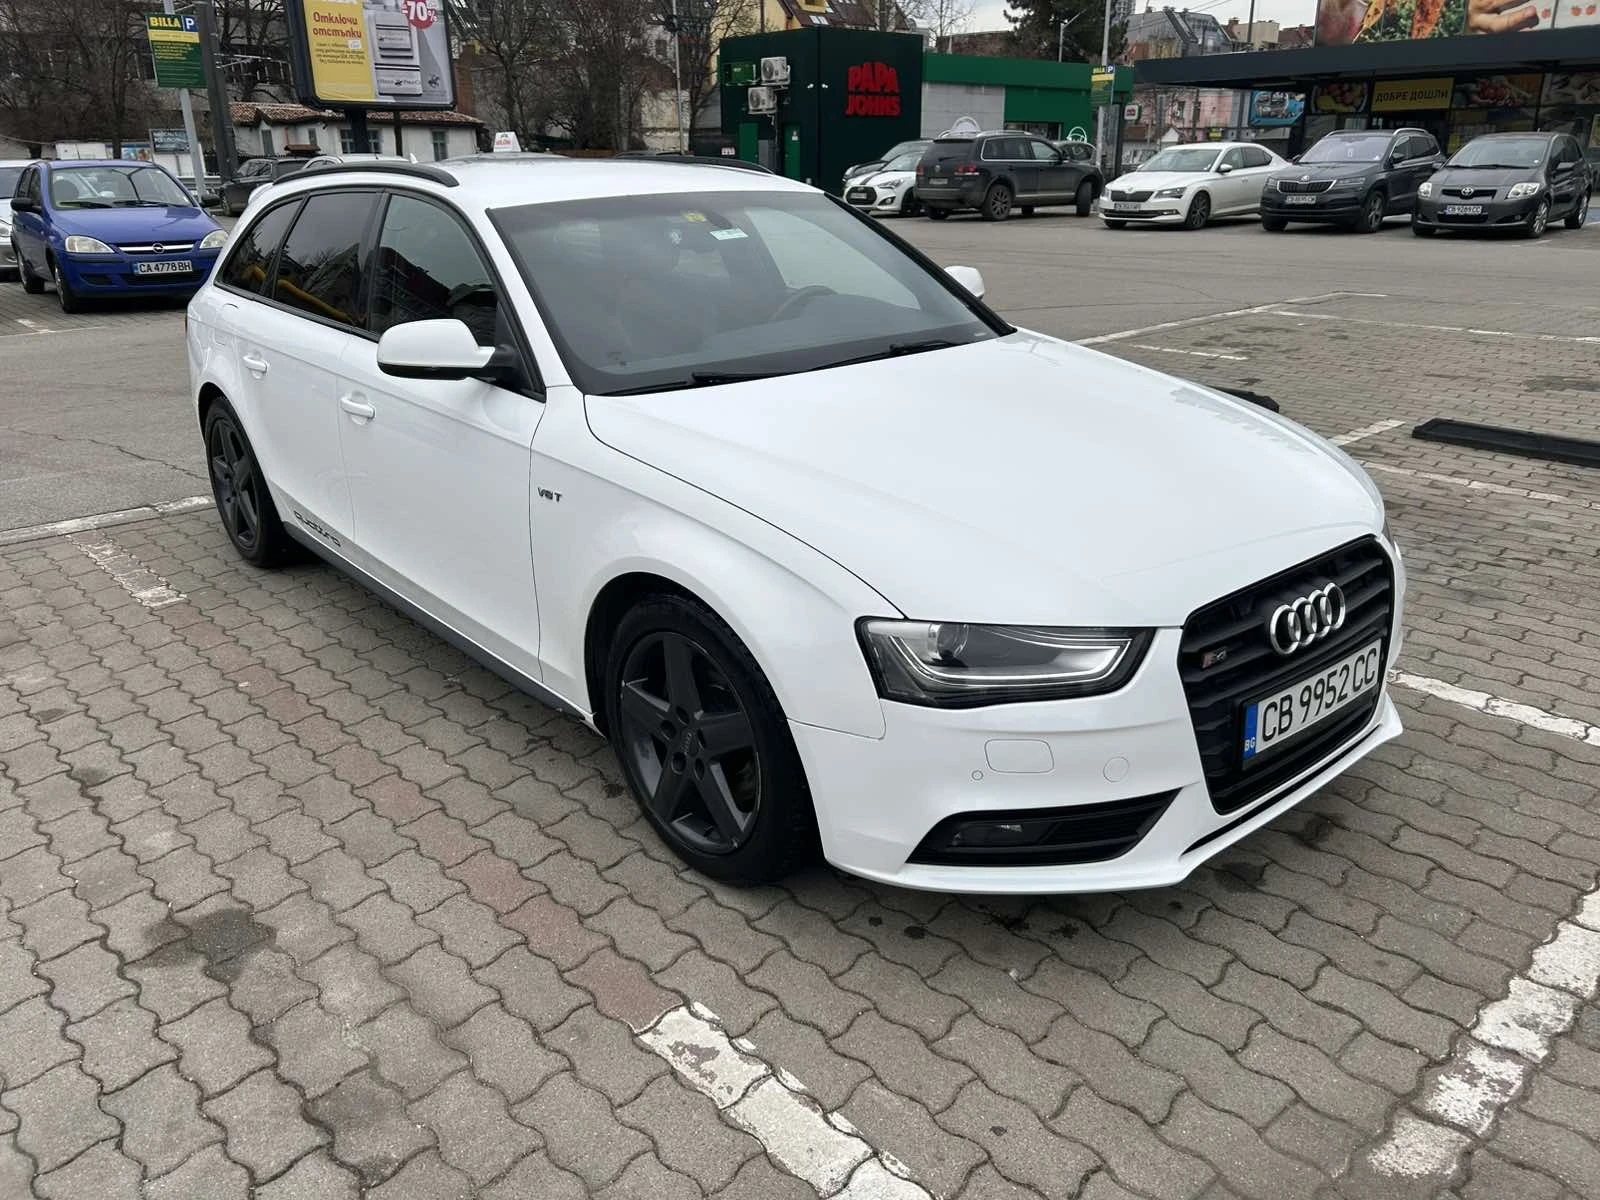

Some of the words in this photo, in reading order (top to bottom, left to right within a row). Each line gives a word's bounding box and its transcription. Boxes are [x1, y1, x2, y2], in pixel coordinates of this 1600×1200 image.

[149, 17, 181, 28] BILLA
[185, 18, 195, 29] P
[313, 12, 358, 25] Отключи
[313, 28, 362, 38] отстъпки
[848, 62, 898, 92] PAPA
[1375, 91, 1409, 103] ДОБРЕ
[1409, 88, 1448, 101] ДОШЛИ
[845, 95, 901, 116] JOHNS
[140, 263, 153, 273] CA
[154, 262, 178, 272] 4778
[178, 261, 190, 271] BH
[1244, 736, 1256, 752] BG
[1262, 694, 1293, 742] CB
[1300, 664, 1349, 723] 9952
[1353, 647, 1377, 692] CC
